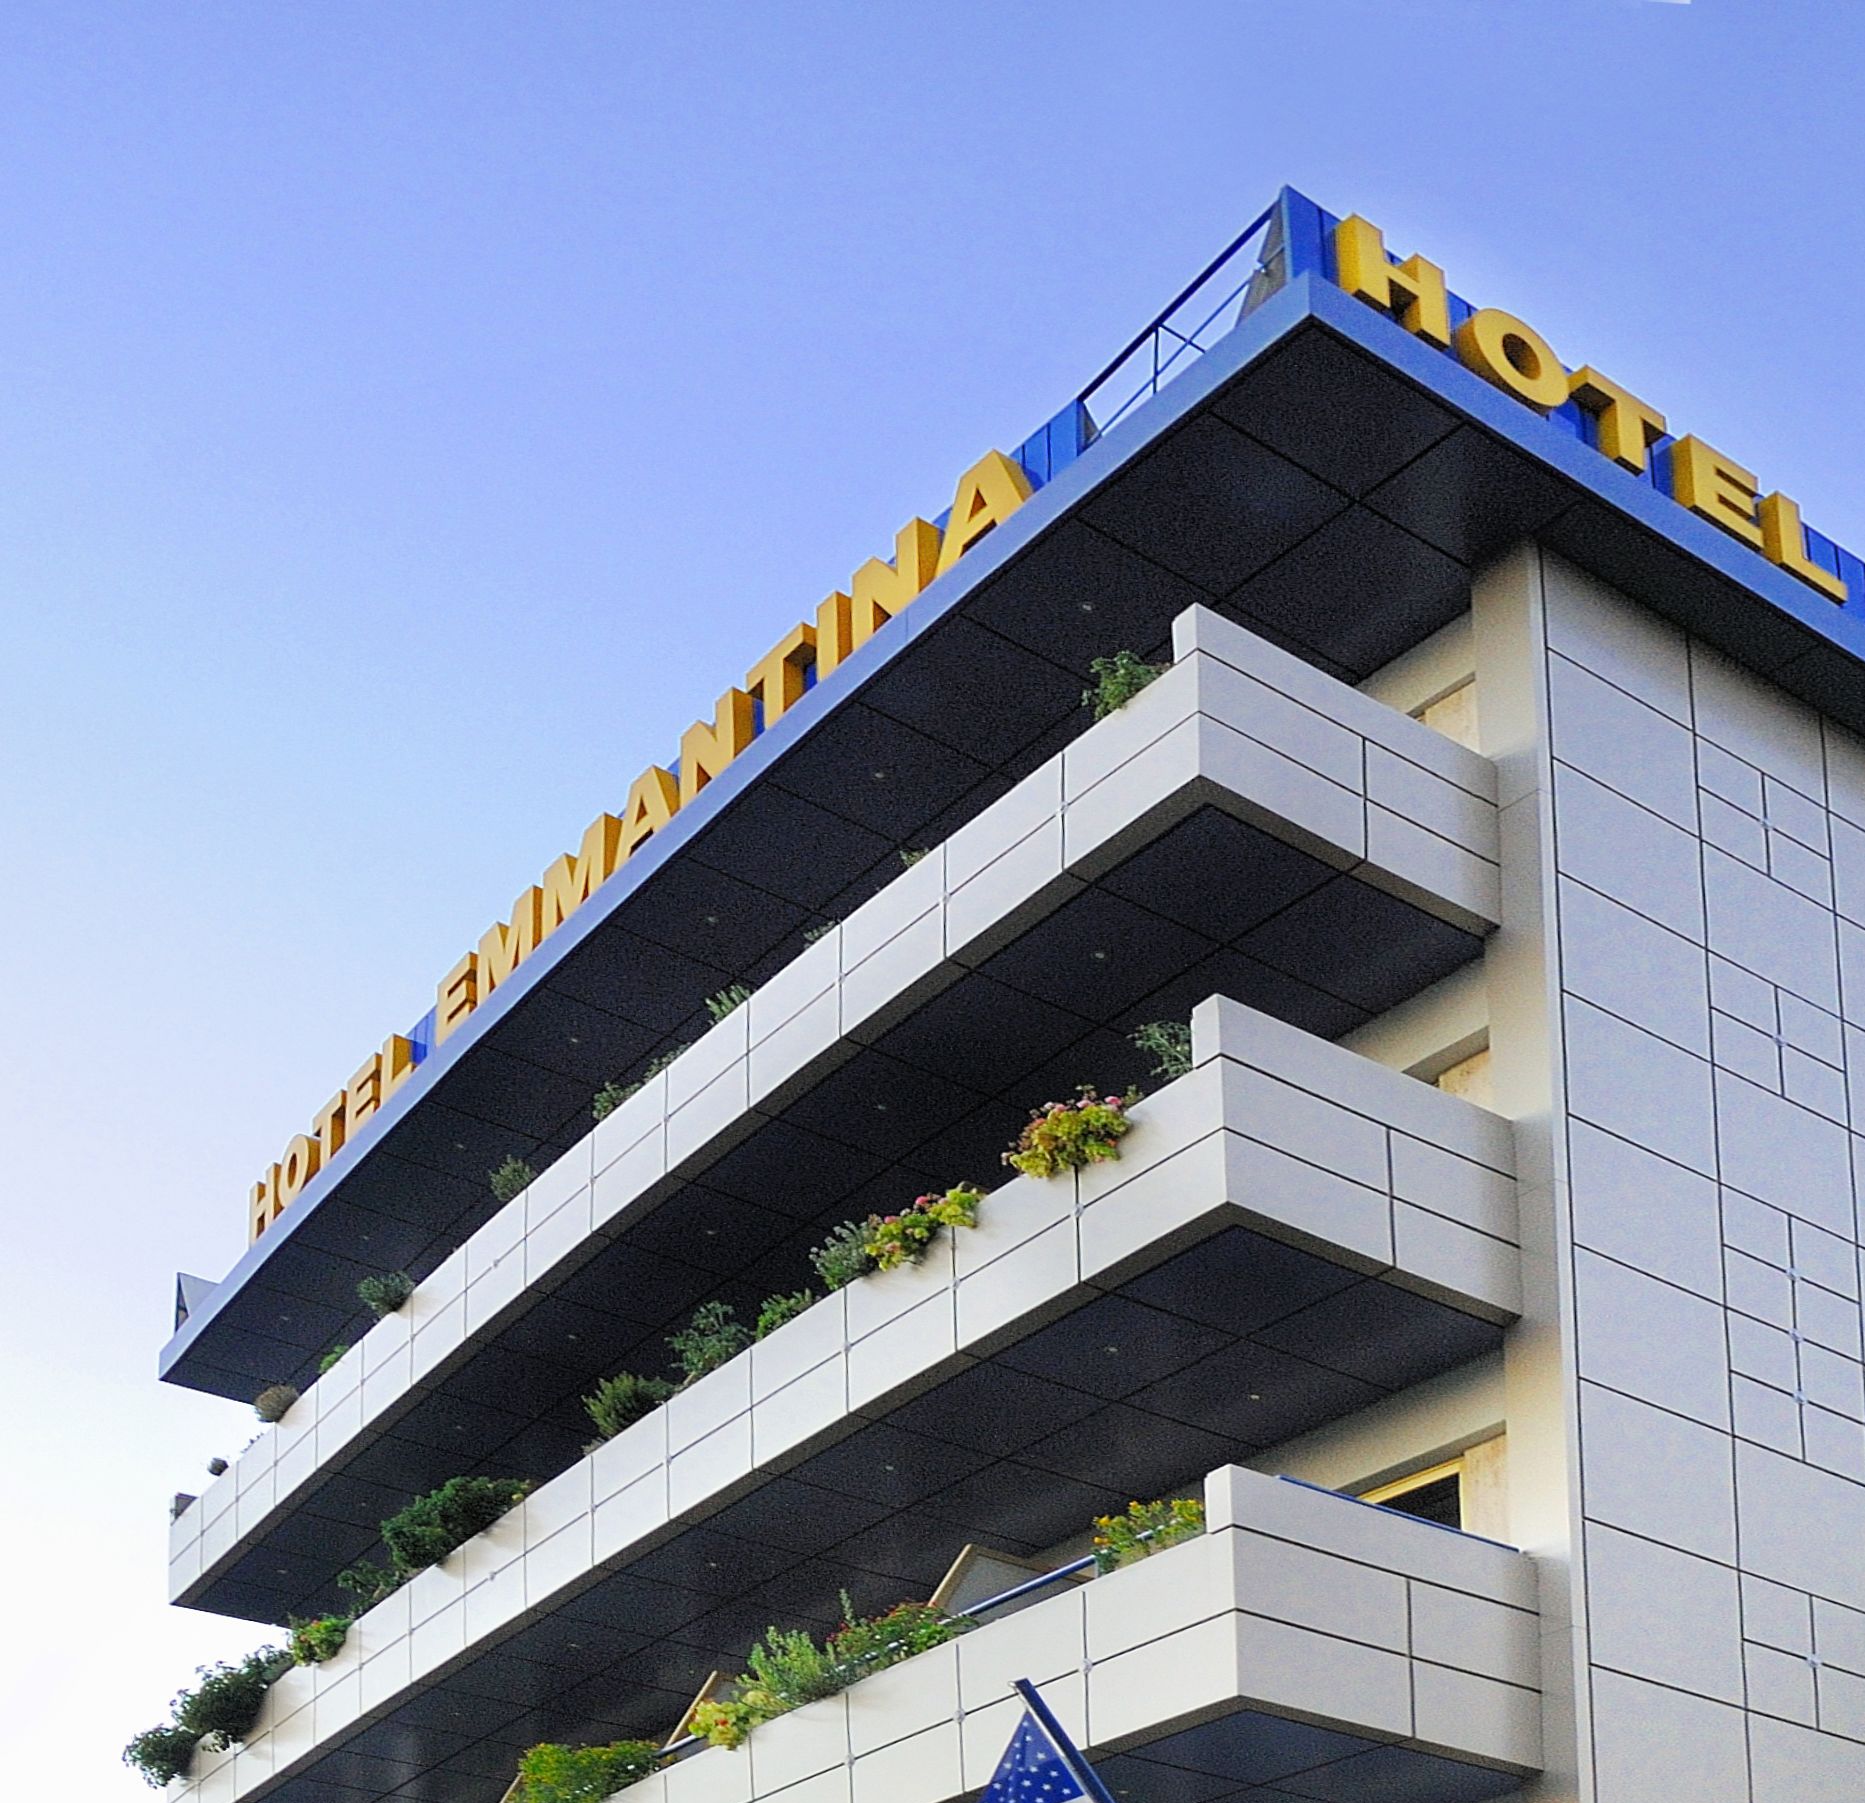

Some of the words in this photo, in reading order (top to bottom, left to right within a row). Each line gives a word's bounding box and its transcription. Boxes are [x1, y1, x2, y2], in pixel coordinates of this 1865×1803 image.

[1336, 213, 1847, 604] HOTEL
[249, 1033, 417, 1247] HOTEL
[436, 449, 1032, 1047] EMMANTINA
